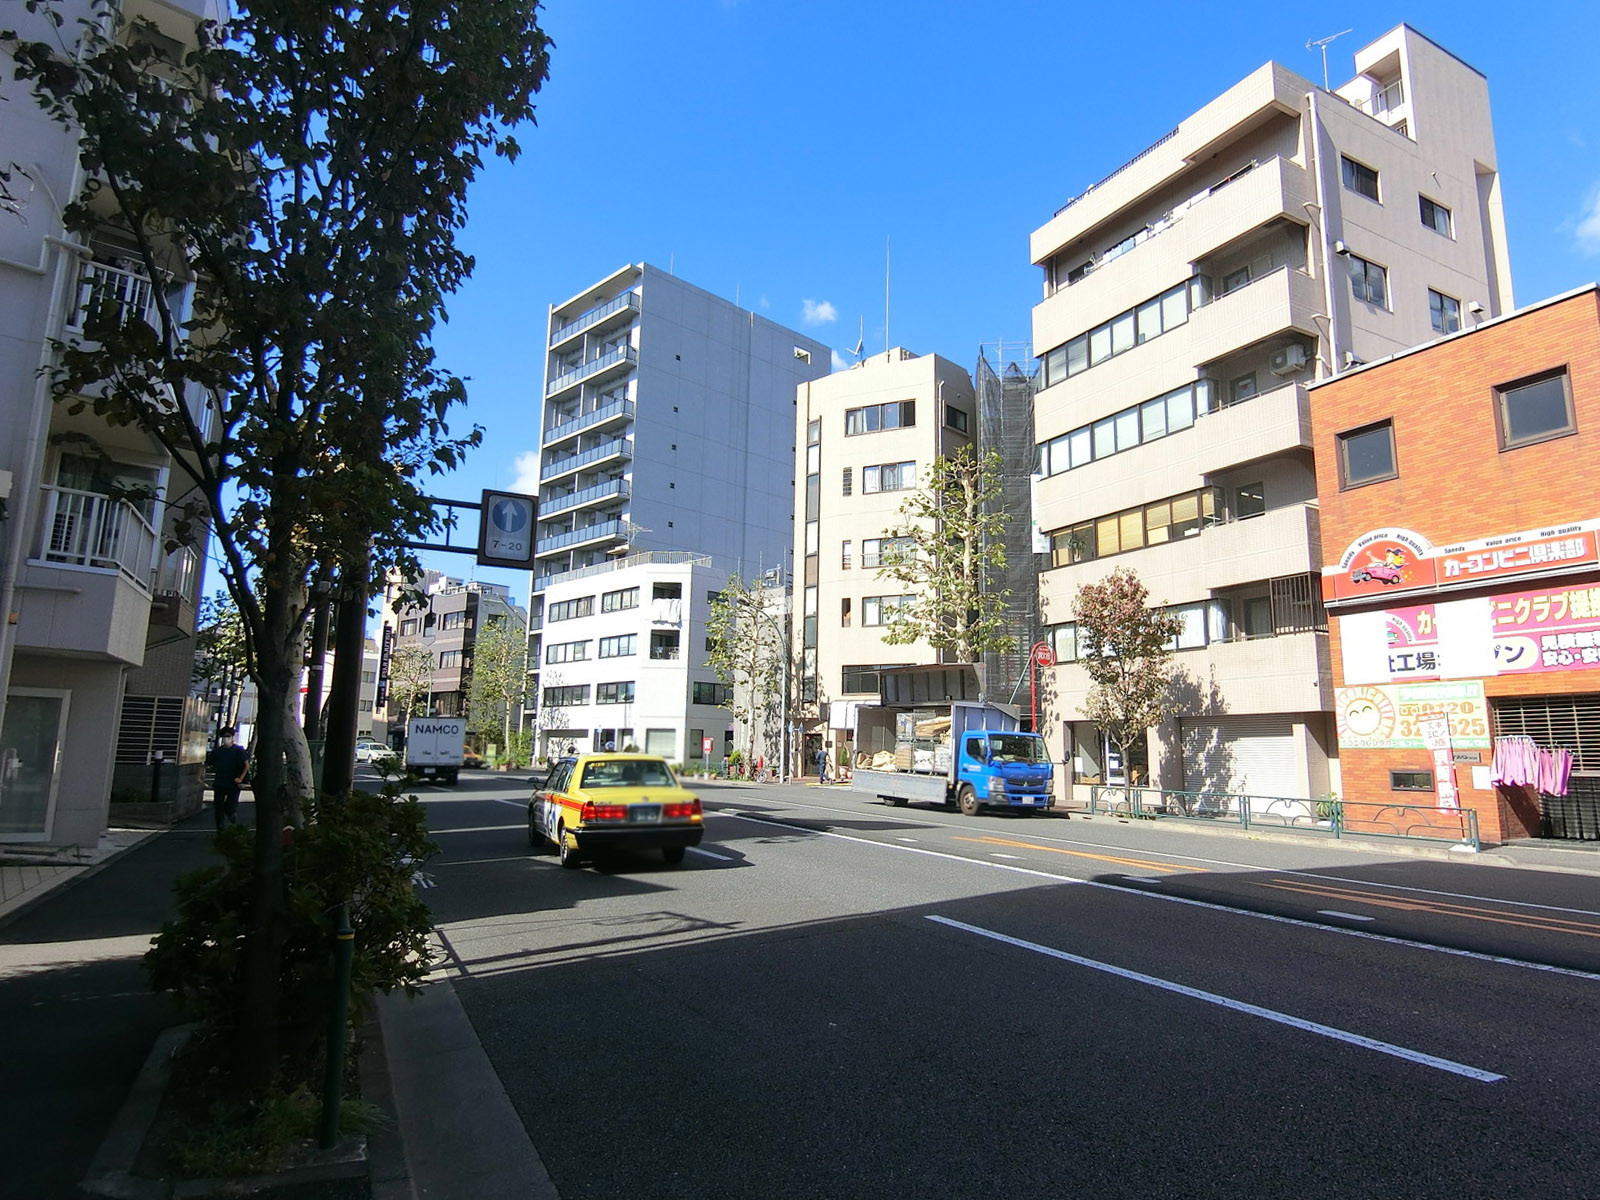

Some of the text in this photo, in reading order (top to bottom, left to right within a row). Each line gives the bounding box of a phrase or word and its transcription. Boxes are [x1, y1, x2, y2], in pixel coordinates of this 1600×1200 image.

[493, 540, 522, 551] 7-20
[1486, 539, 1503, 547] Value
[1541, 529, 1555, 537] High
[1558, 525, 1582, 535] quality
[1443, 537, 1586, 577] カーコンビニ倶楽部
[1416, 610, 1436, 635] カ
[1388, 651, 1440, 673] 工場
[415, 725, 459, 734] NAMCO
